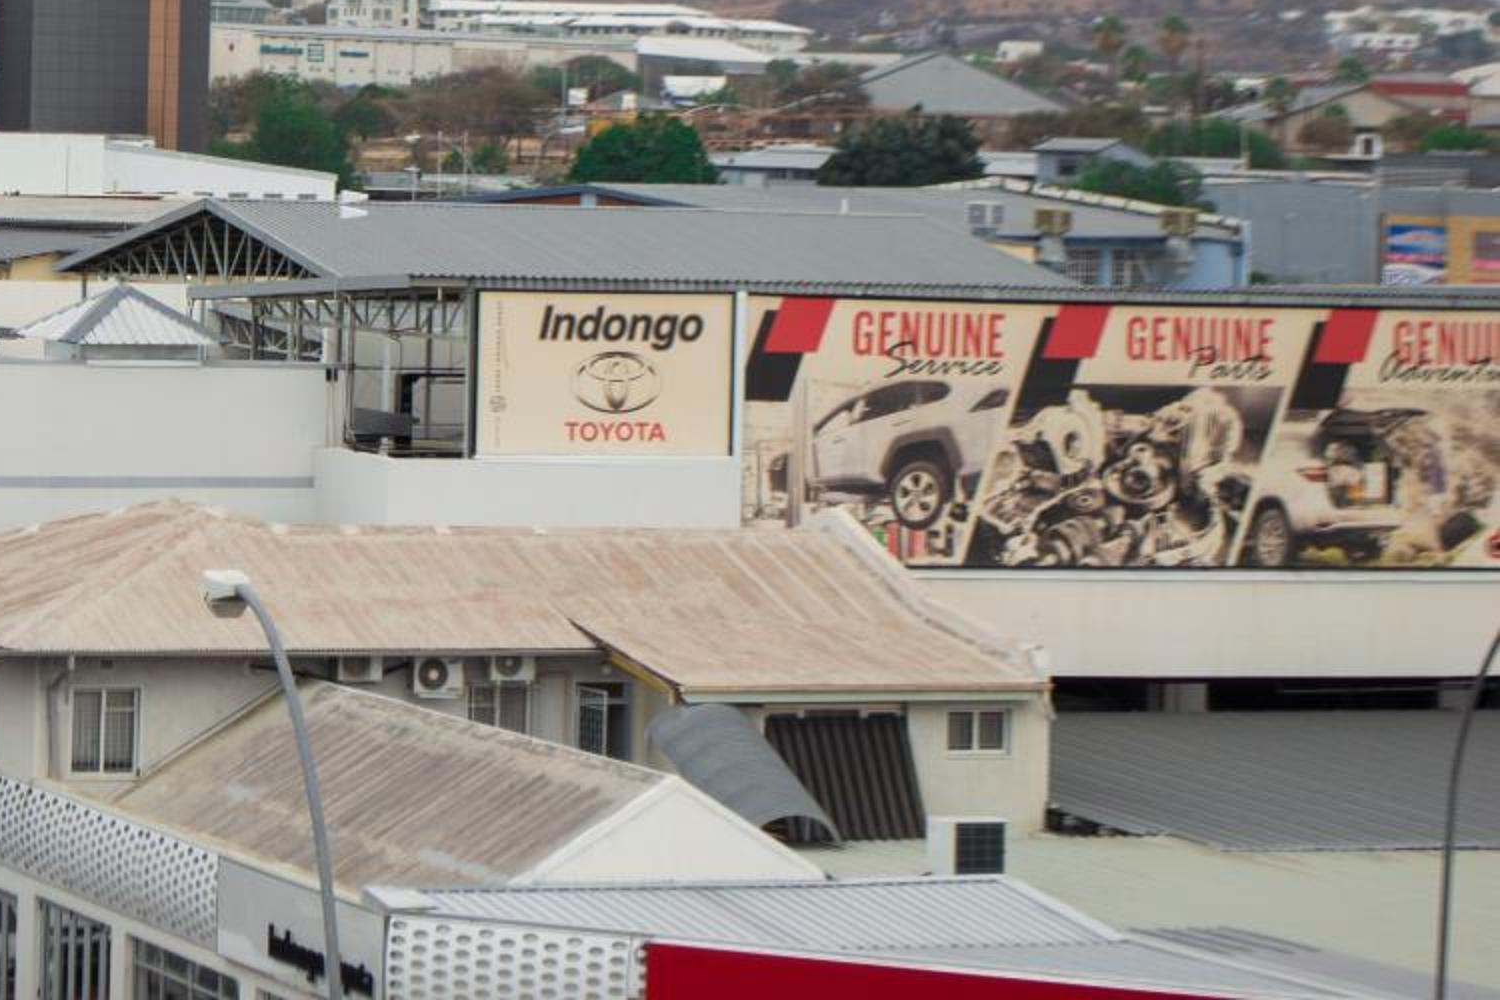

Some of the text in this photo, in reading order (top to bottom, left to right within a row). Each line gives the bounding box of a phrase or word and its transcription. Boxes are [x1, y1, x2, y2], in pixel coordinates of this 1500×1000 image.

[539, 305, 704, 350] Indongo
[852, 310, 1005, 357] GENUINE
[1126, 315, 1274, 361] GENUINE
[1393, 320, 1500, 366] GENUI
[884, 341, 1003, 378] Service
[1188, 345, 1273, 380] Parts
[565, 422, 666, 442] TOYOTA
